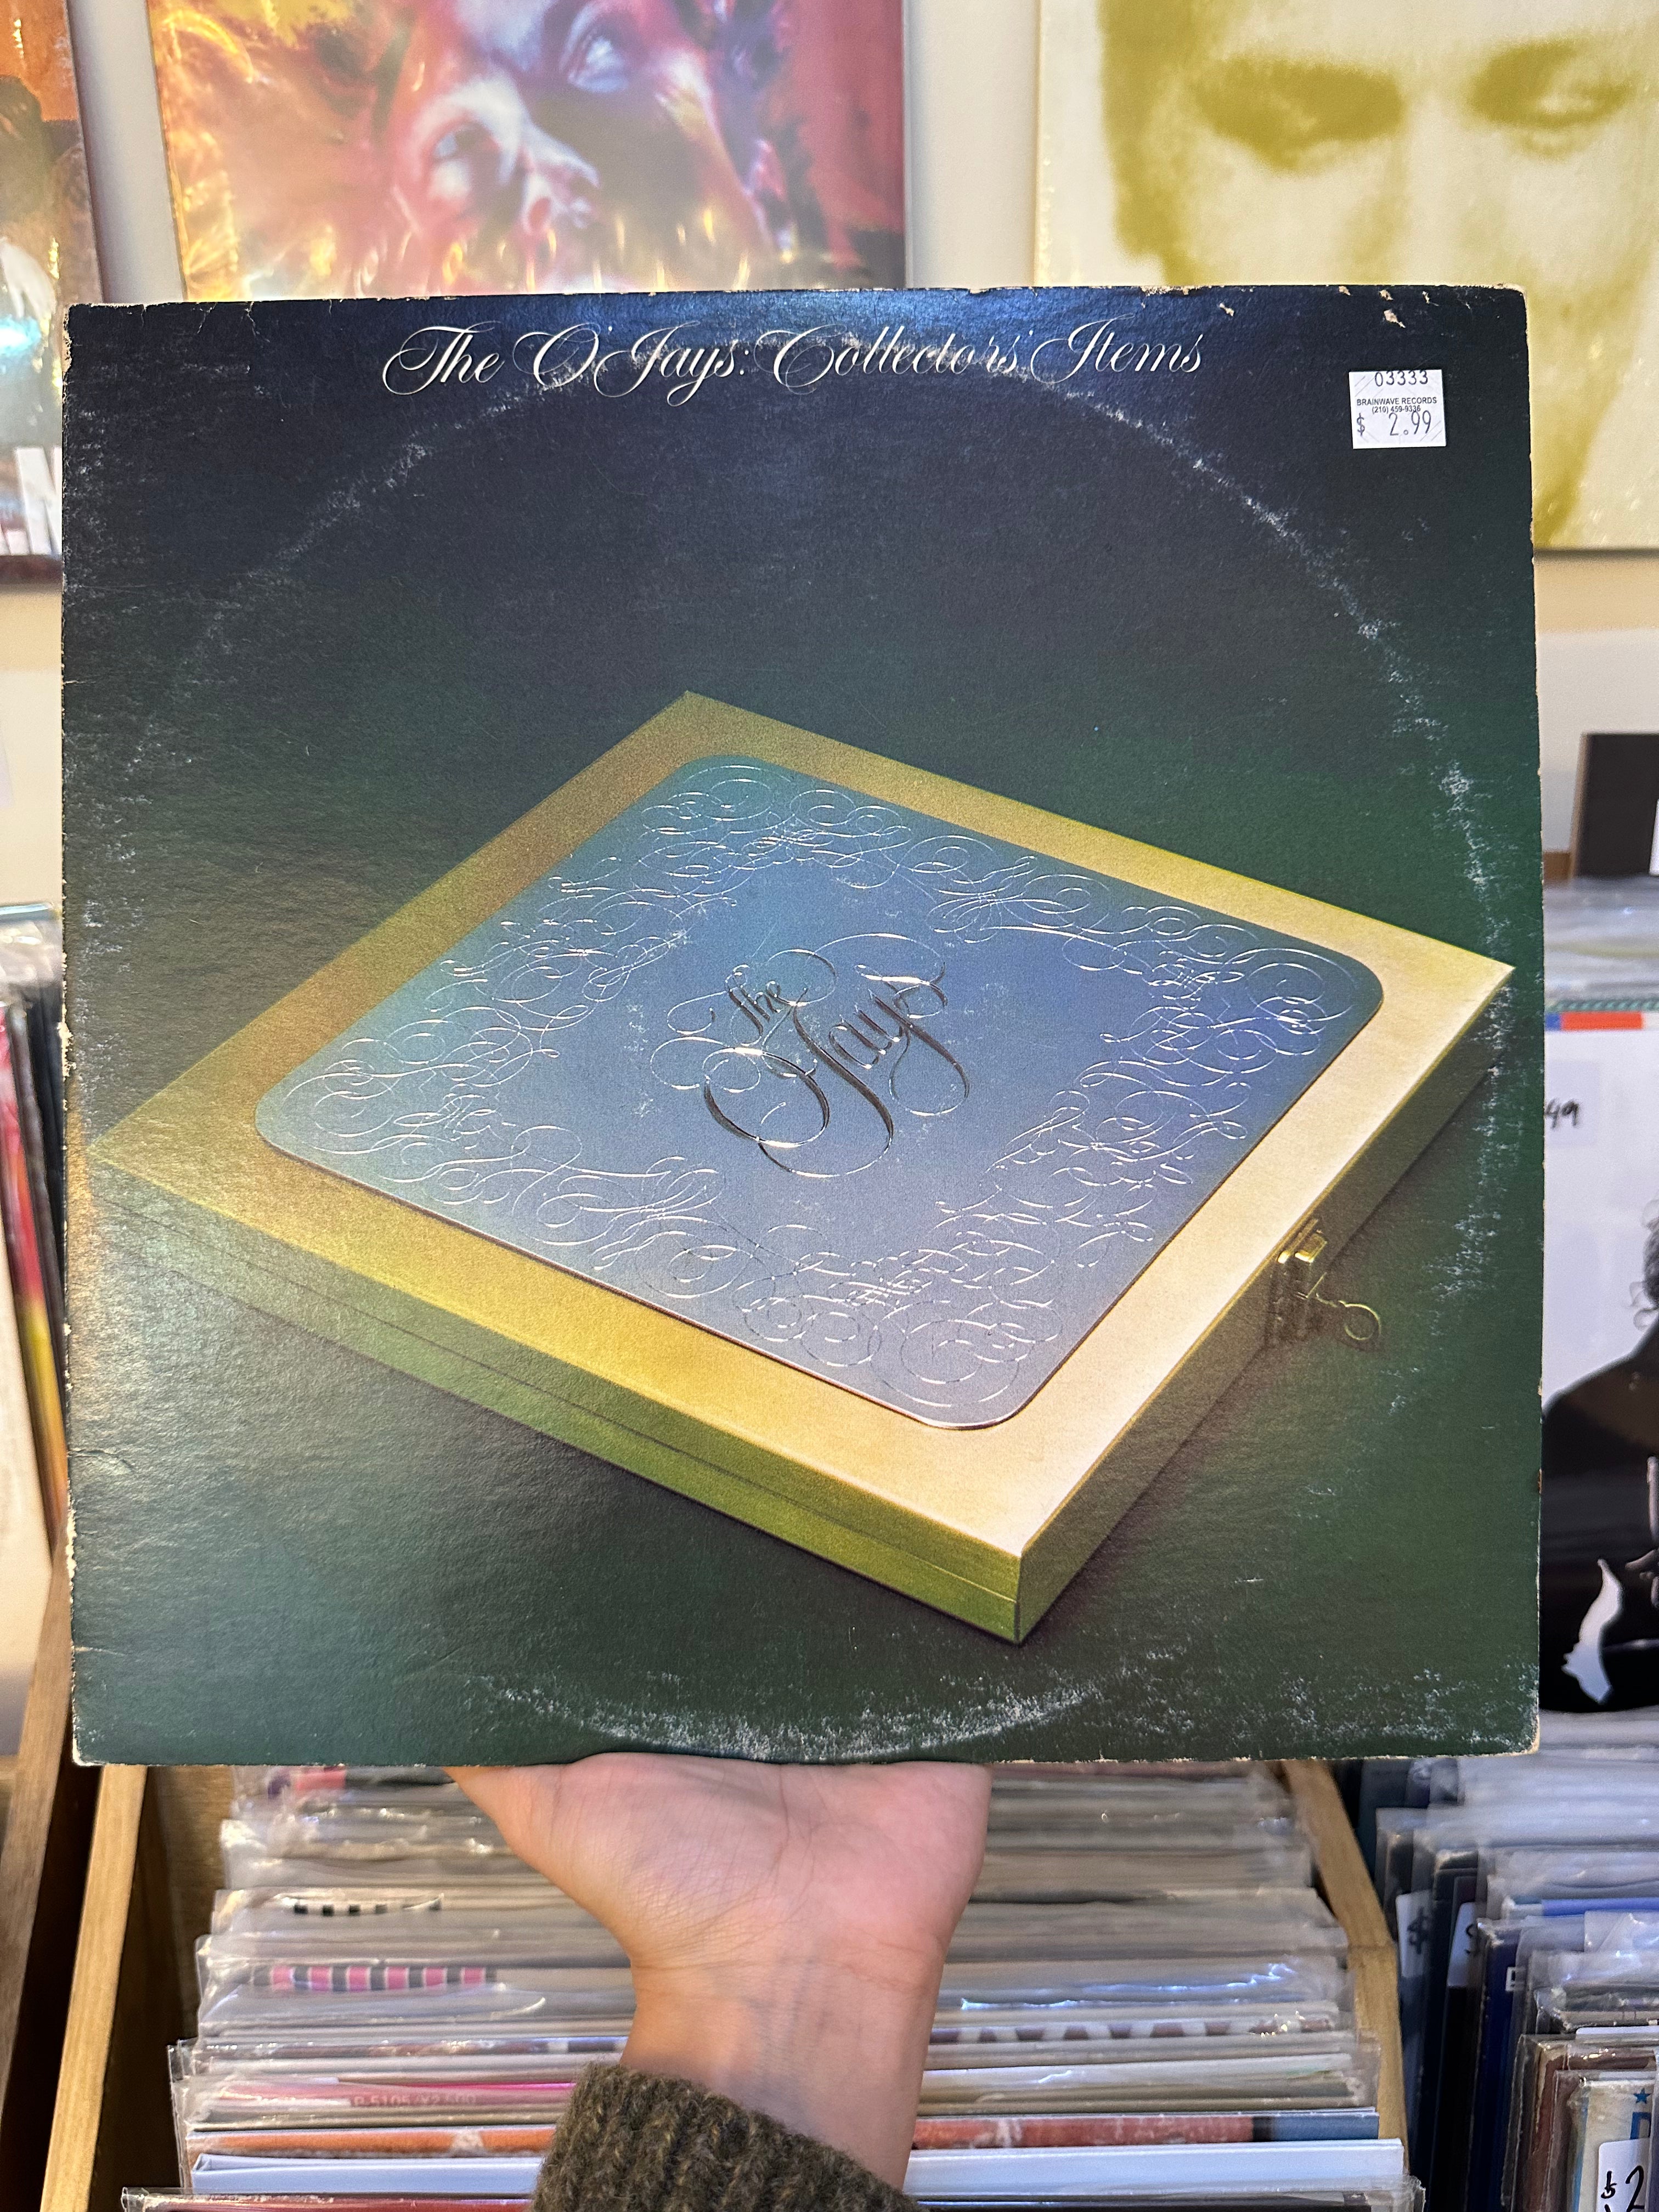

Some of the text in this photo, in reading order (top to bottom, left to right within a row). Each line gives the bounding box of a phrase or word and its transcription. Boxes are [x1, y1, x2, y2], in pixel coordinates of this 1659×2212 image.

[382, 320, 505, 395] The
[1030, 313, 1203, 383] Items
[1375, 370, 1427, 386] 03333
[1357, 397, 1437, 406] BRAINWAVE RECORDS
[1357, 410, 1431, 437] $ 2.99
